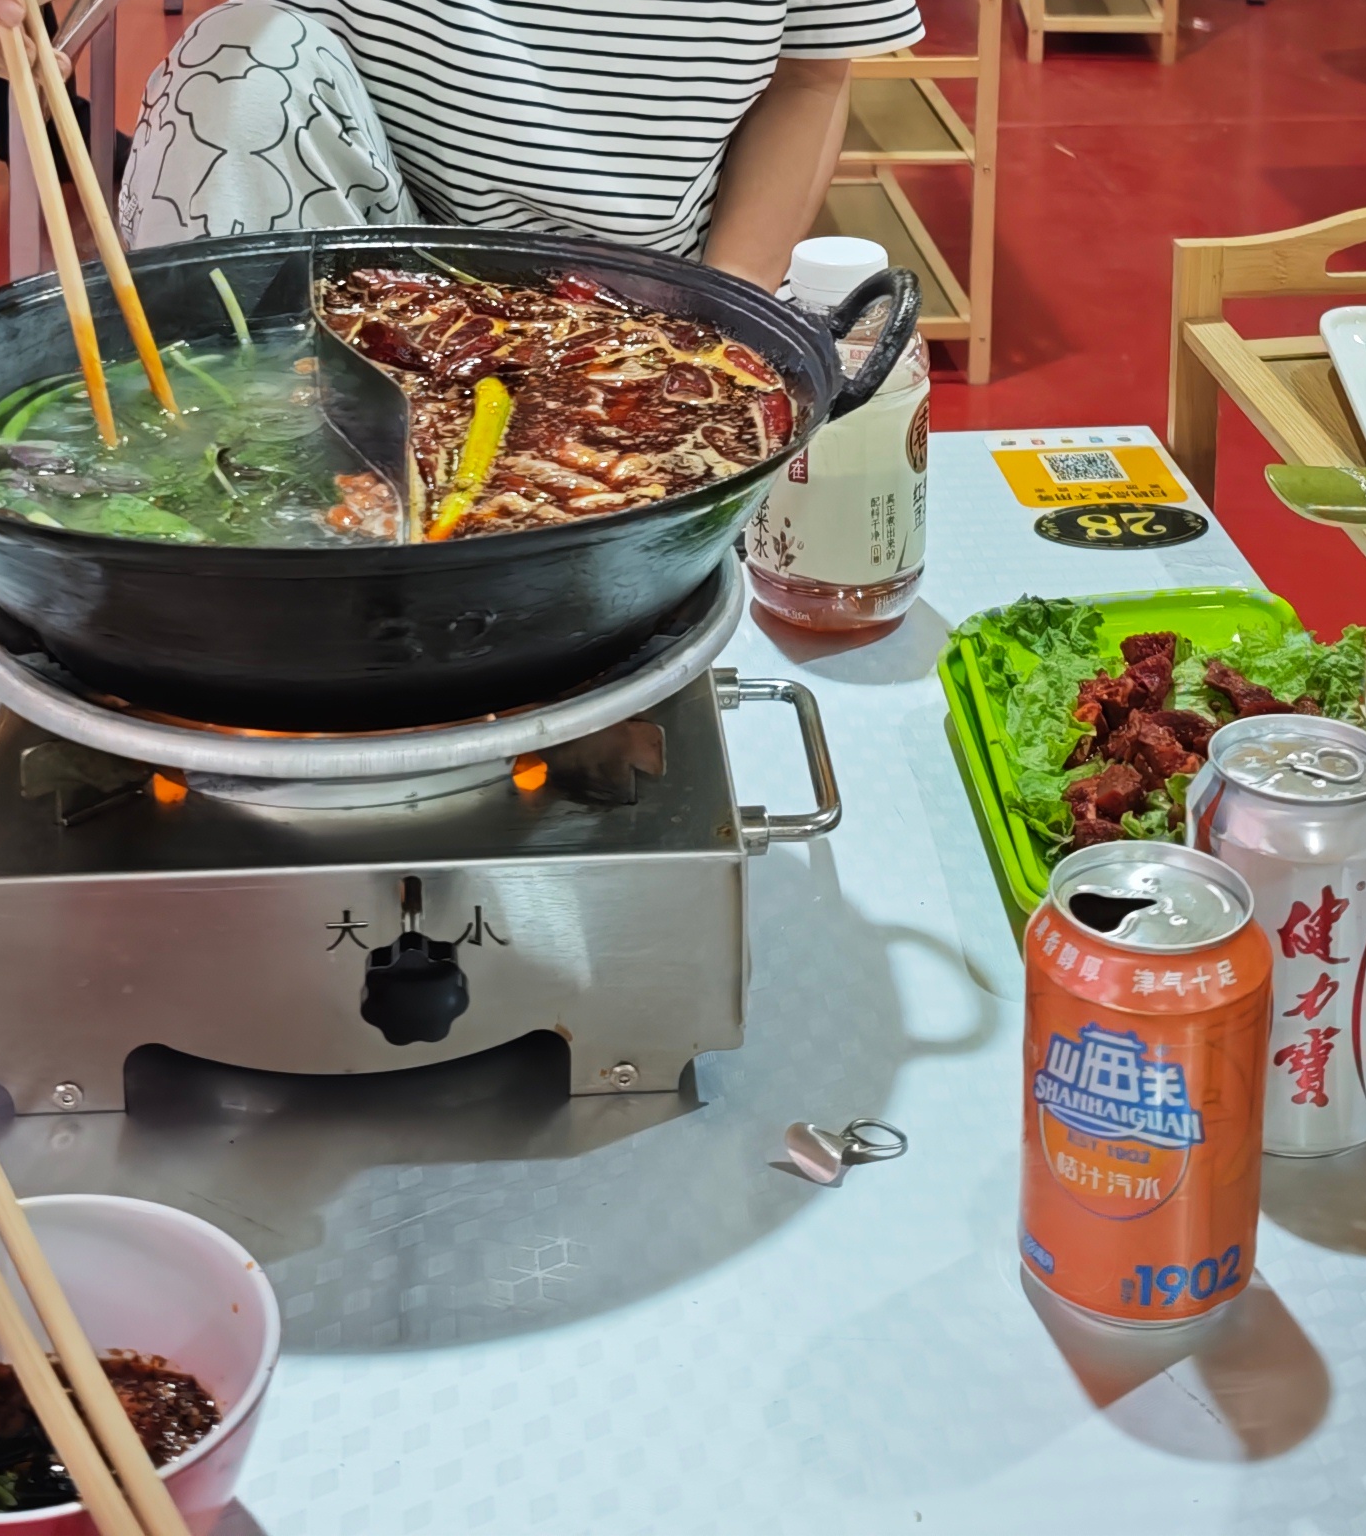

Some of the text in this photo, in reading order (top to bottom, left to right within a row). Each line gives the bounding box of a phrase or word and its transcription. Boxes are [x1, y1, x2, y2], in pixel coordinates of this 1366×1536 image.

[1077, 511, 1167, 540] 28
[326, 904, 511, 952] 大 小
[1132, 958, 1238, 997] 津气十足
[1047, 1030, 1185, 1107] 山海关
[1034, 1073, 1202, 1141] SHANHAIGUAN
[1135, 1244, 1241, 1307] 1902
